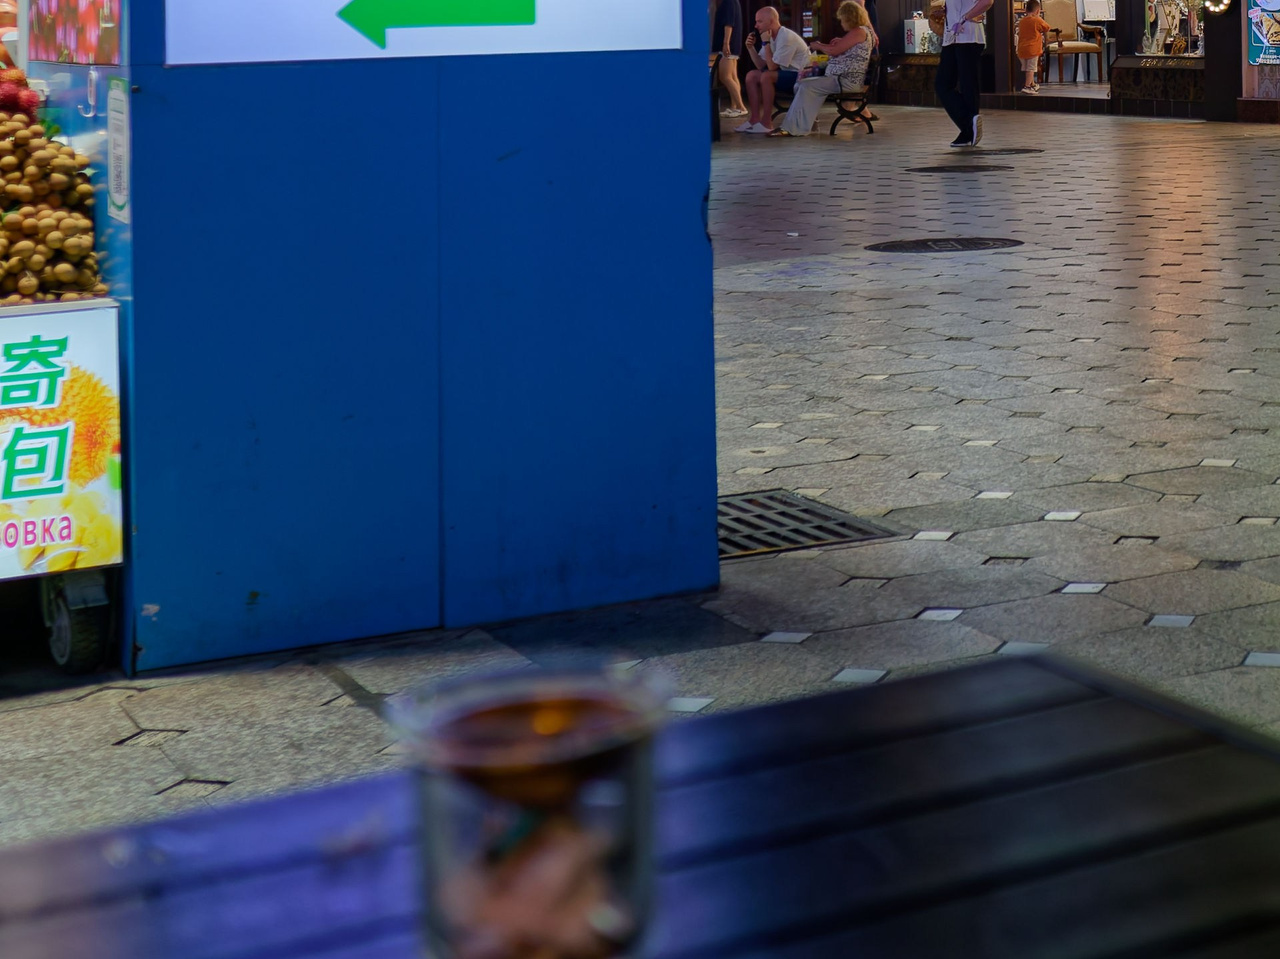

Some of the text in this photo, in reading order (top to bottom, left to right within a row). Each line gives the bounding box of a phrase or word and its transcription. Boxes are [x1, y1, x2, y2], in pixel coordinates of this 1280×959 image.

[0, 334, 69, 408] 寄
[1, 425, 72, 502] 包
[0, 515, 73, 550] овка
